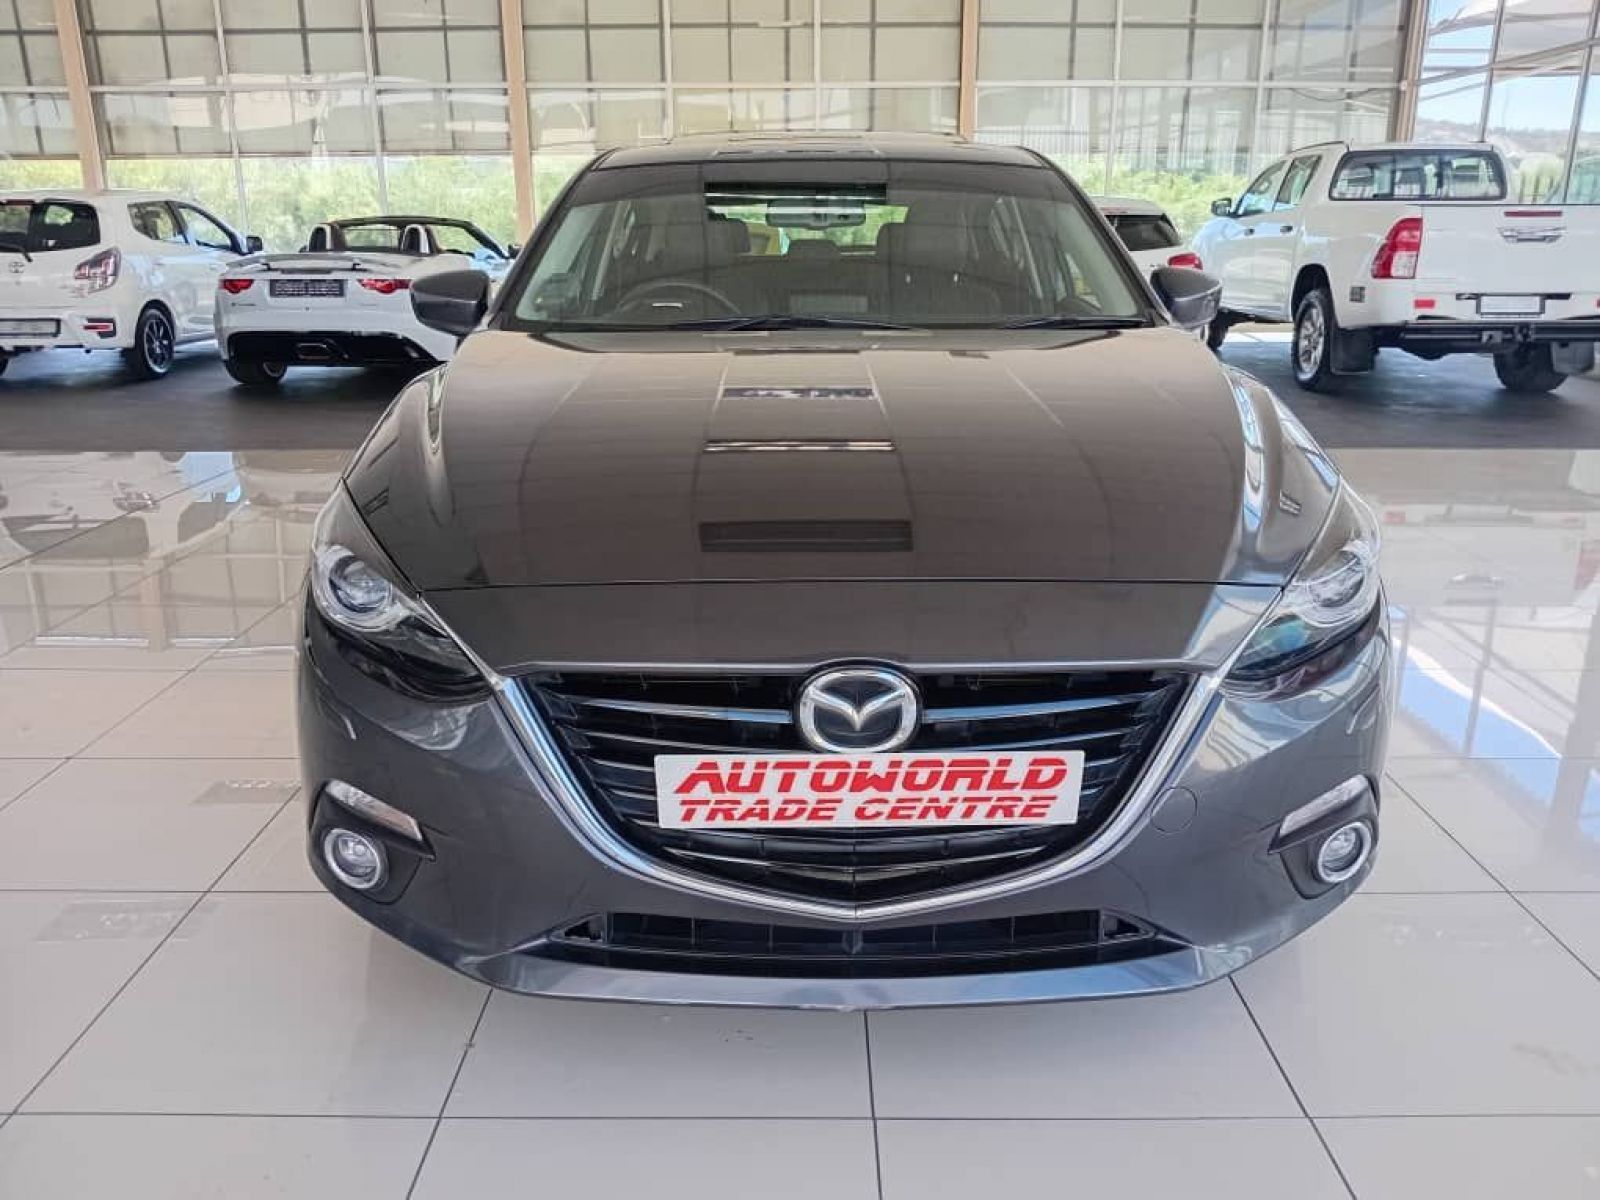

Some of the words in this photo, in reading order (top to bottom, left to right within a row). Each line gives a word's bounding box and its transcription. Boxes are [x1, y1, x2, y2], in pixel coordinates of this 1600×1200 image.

[675, 758, 1068, 794] AUTOWORLD
[680, 797, 842, 822] TRADE
[854, 795, 1057, 821] CENTRE
